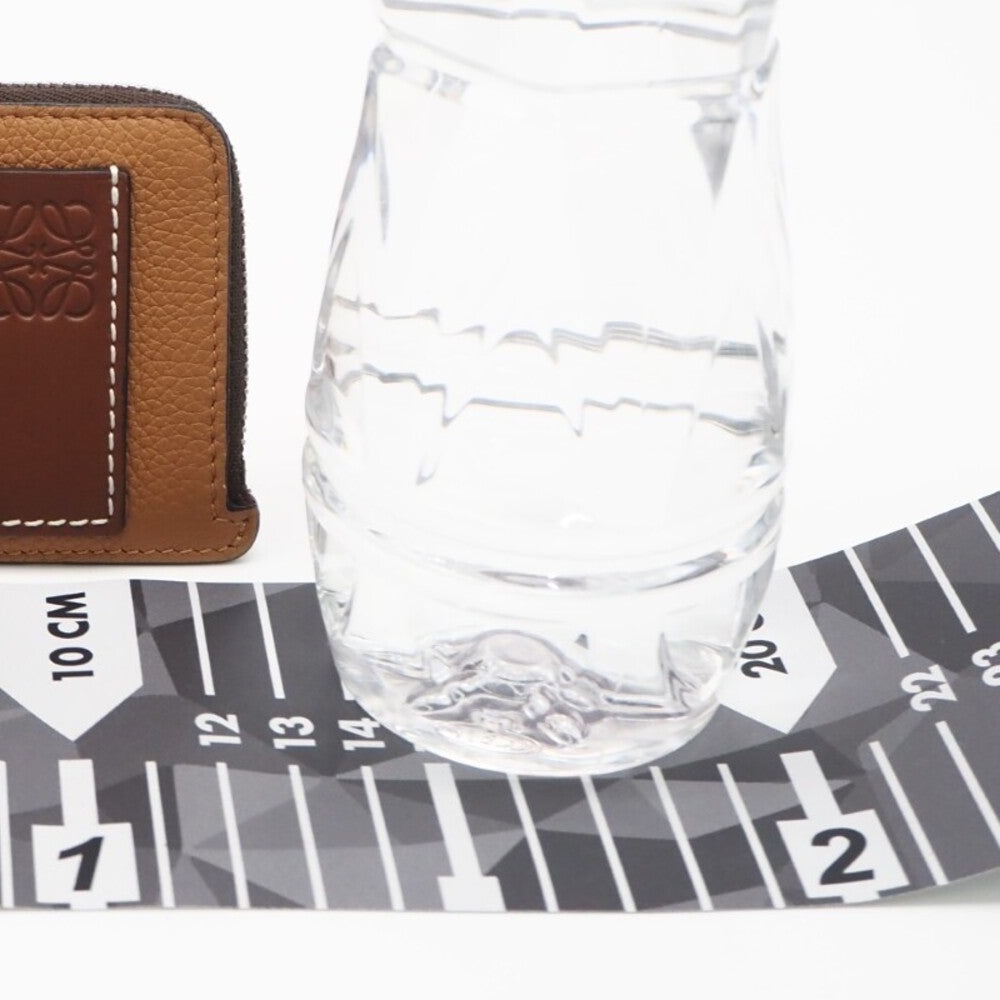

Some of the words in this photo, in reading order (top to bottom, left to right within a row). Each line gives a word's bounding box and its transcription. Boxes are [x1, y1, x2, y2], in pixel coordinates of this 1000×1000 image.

[45, 591, 90, 640] CM
[49, 646, 94, 682] 10
[740, 639, 788, 678] 20
[900, 664, 958, 712] 22
[194, 712, 242, 747] 12
[268, 716, 316, 750] 13
[337, 717, 386, 751] 14
[58, 836, 104, 891] 1
[811, 827, 875, 886] 2
